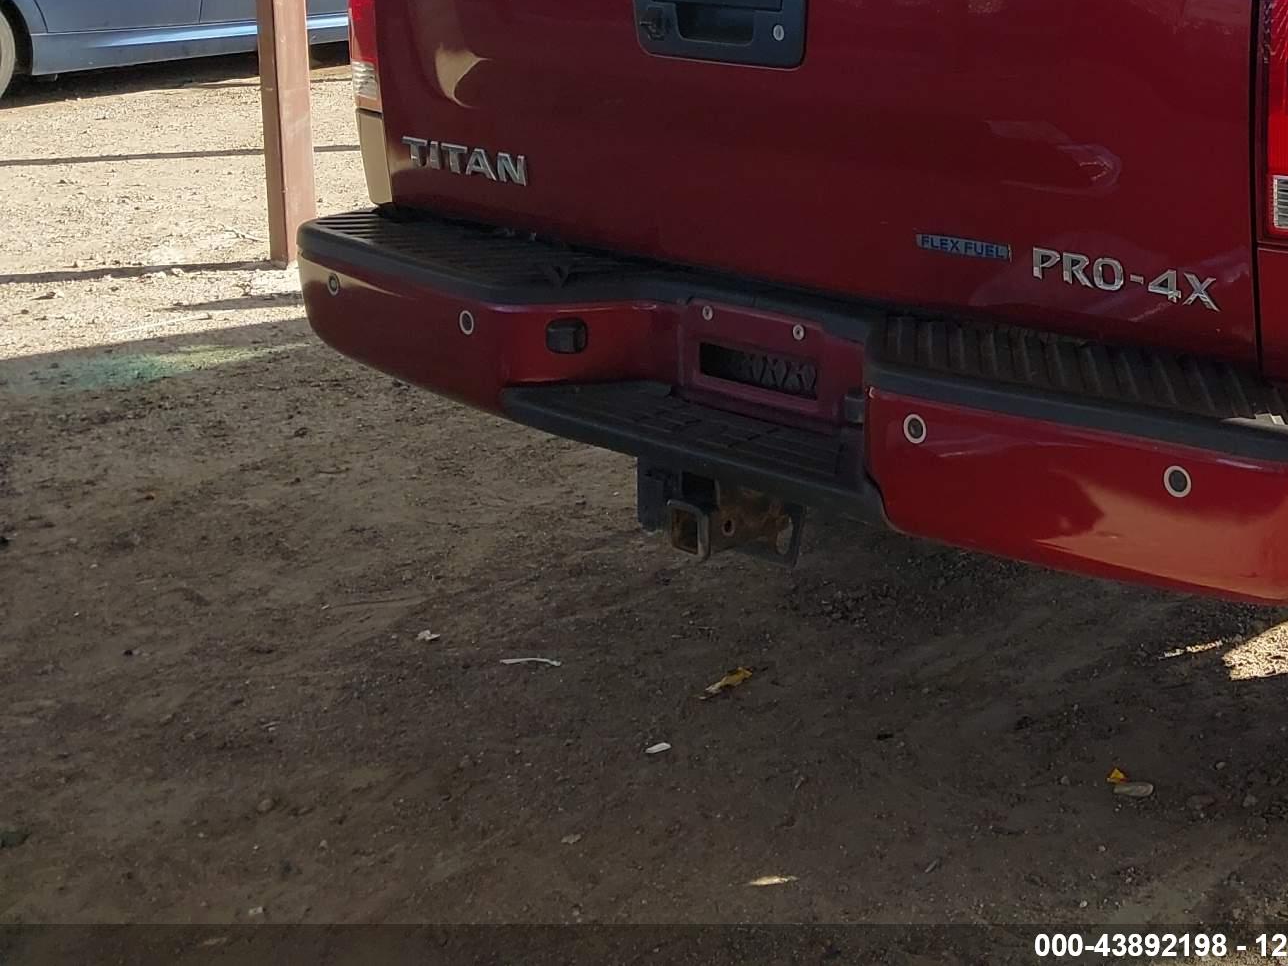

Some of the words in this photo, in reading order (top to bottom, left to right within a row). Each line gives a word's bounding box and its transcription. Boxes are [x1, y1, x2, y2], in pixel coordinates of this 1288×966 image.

[402, 136, 527, 187] TITAN
[920, 234, 961, 253] FLEX
[963, 240, 1008, 260] FUEL
[1031, 245, 1221, 313] PRO-4X
